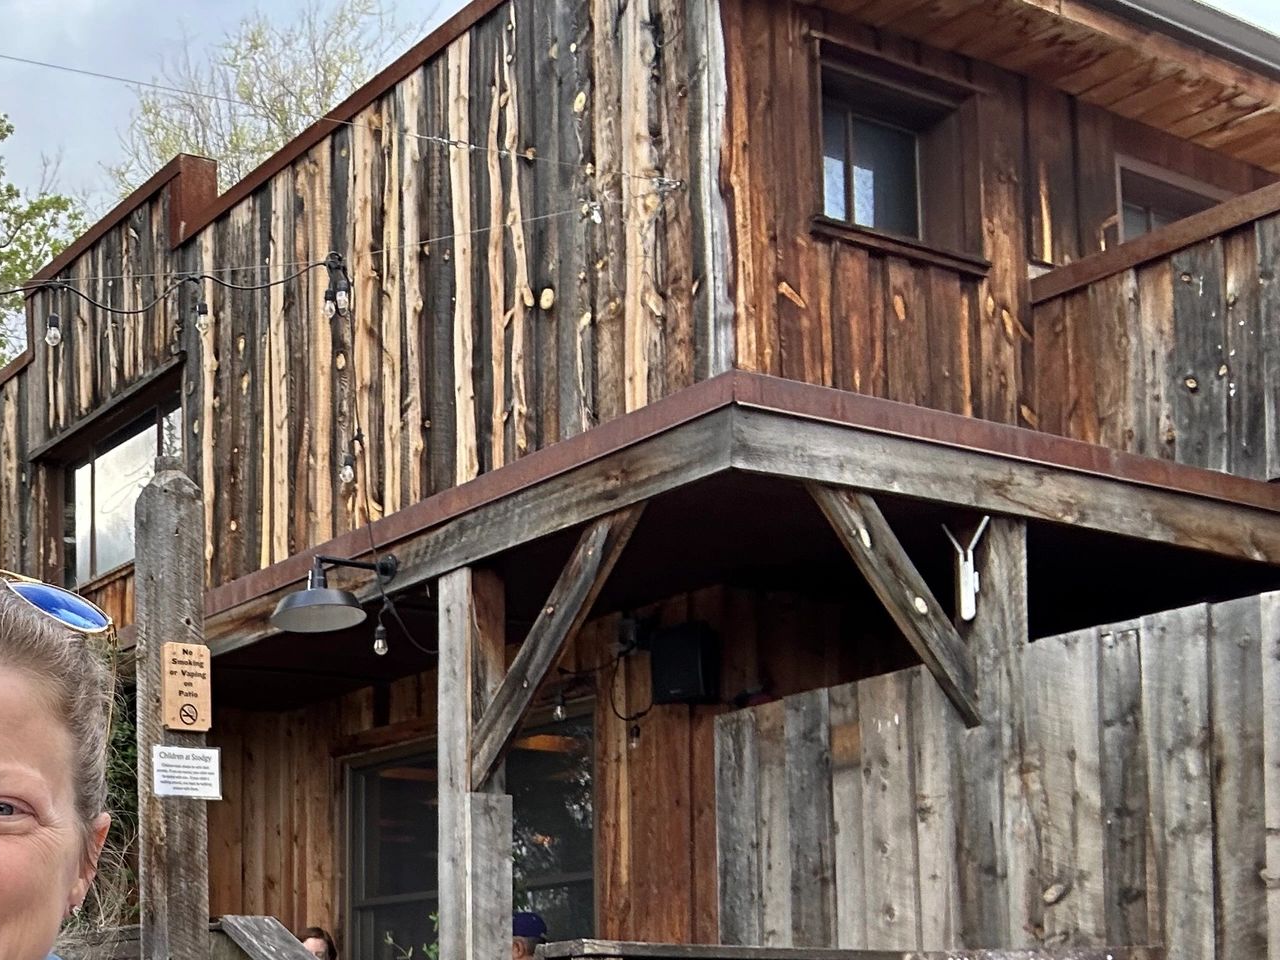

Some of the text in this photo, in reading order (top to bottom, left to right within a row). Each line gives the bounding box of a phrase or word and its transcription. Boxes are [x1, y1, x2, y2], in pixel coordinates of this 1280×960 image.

[182, 648, 193, 656] No
[171, 658, 204, 669] Smoking
[181, 669, 206, 680] Vaping
[178, 690, 198, 698] Patio
[159, 751, 184, 760] Children
